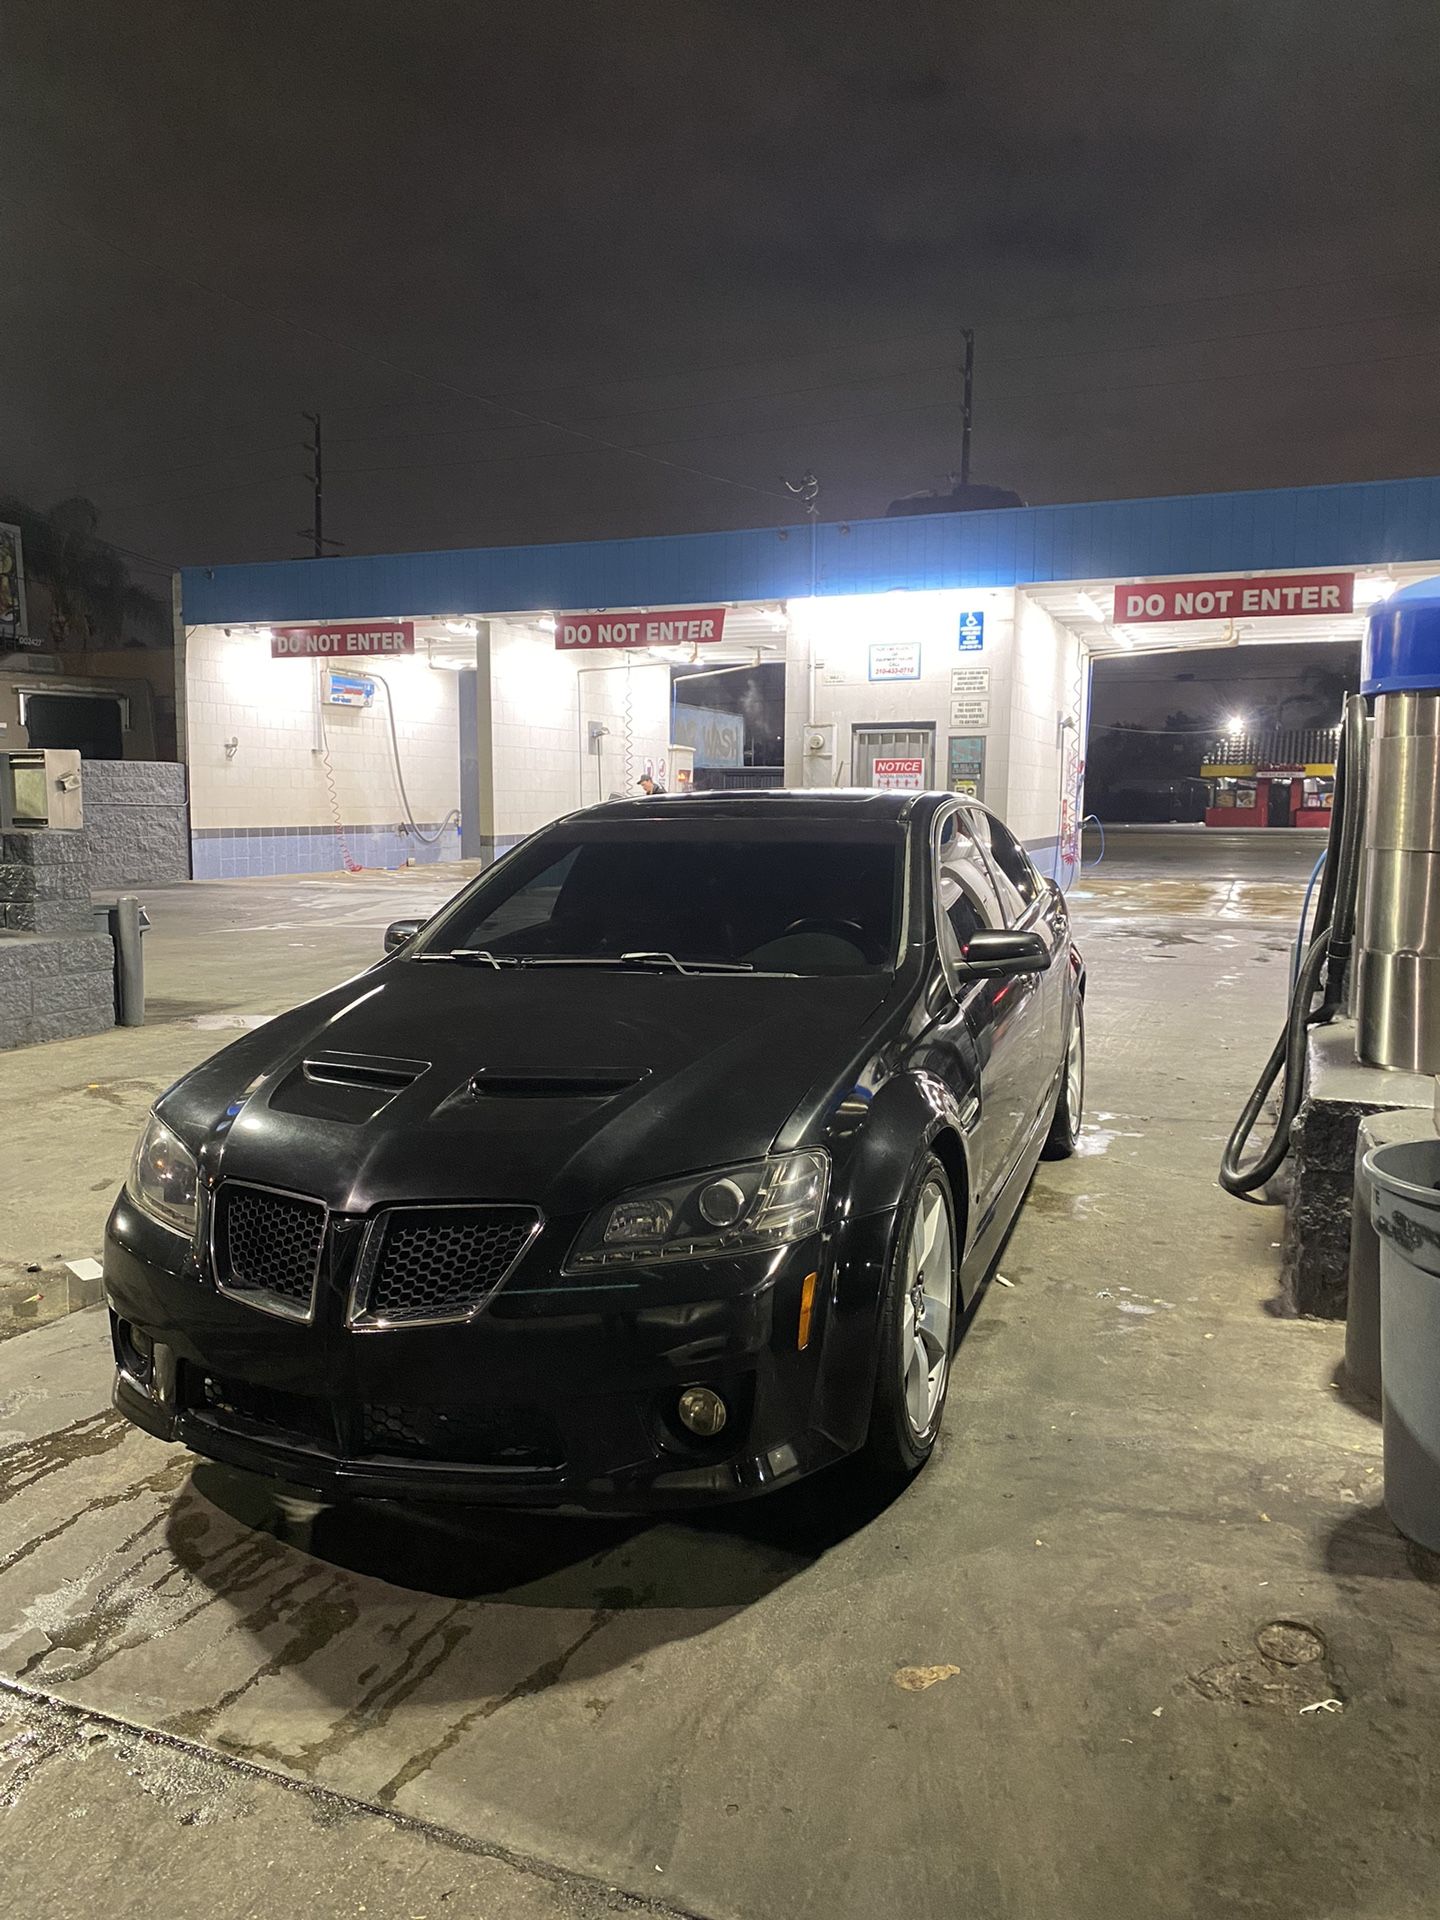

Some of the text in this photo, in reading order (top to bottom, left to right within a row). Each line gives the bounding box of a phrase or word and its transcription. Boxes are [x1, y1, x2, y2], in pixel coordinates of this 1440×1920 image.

[1127, 585, 1342, 617] DO NOT ENTER
[277, 632, 406, 653] DO NOT ENTER
[564, 620, 716, 644] DO NOT ENTER
[876, 761, 921, 773] NOTICE
